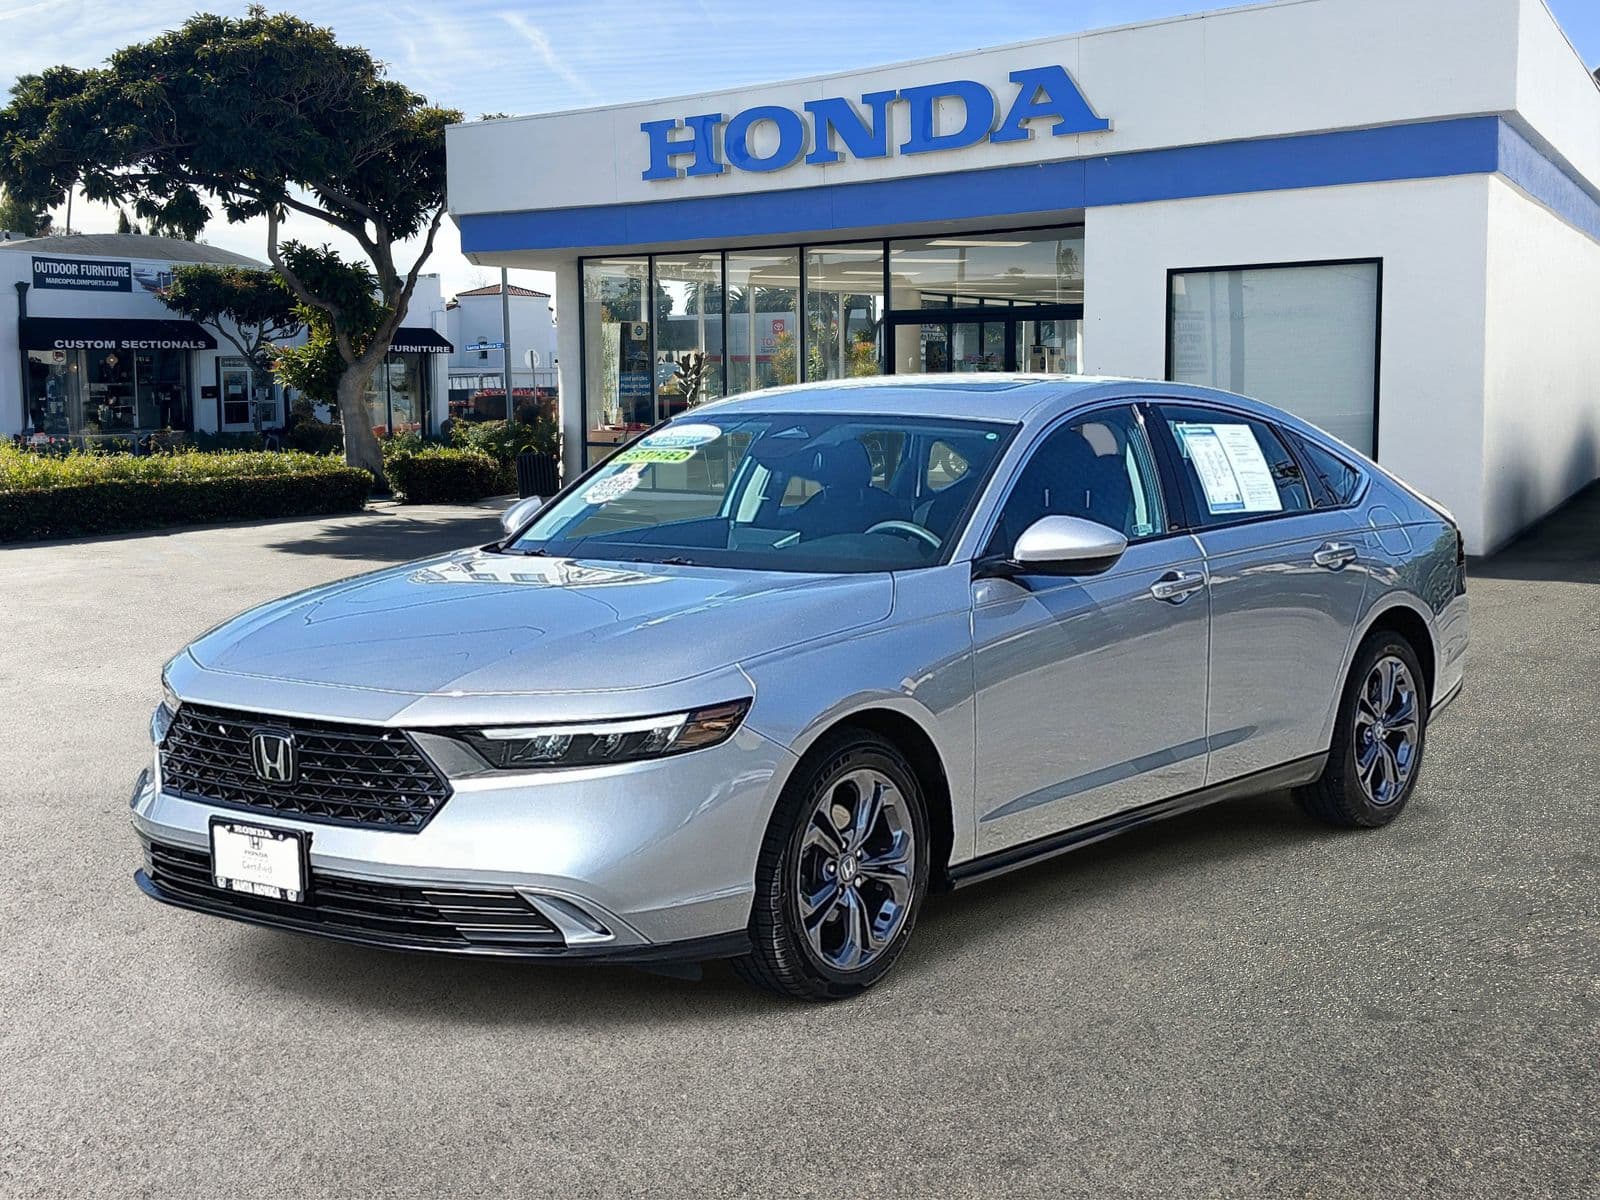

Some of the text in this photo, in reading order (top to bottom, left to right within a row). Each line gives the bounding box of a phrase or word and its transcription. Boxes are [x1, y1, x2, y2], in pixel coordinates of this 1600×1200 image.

[640, 64, 1112, 183] HONDA
[34, 261, 130, 278] OUTDOOR FURNITURE
[45, 277, 119, 287] MARCOPOLOIMPORTS.COM
[54, 340, 207, 349] CUSTOM SECTIONALS
[388, 345, 450, 353] FURNITURE
[233, 824, 274, 838] HONDA
[242, 860, 273, 874] Certified
